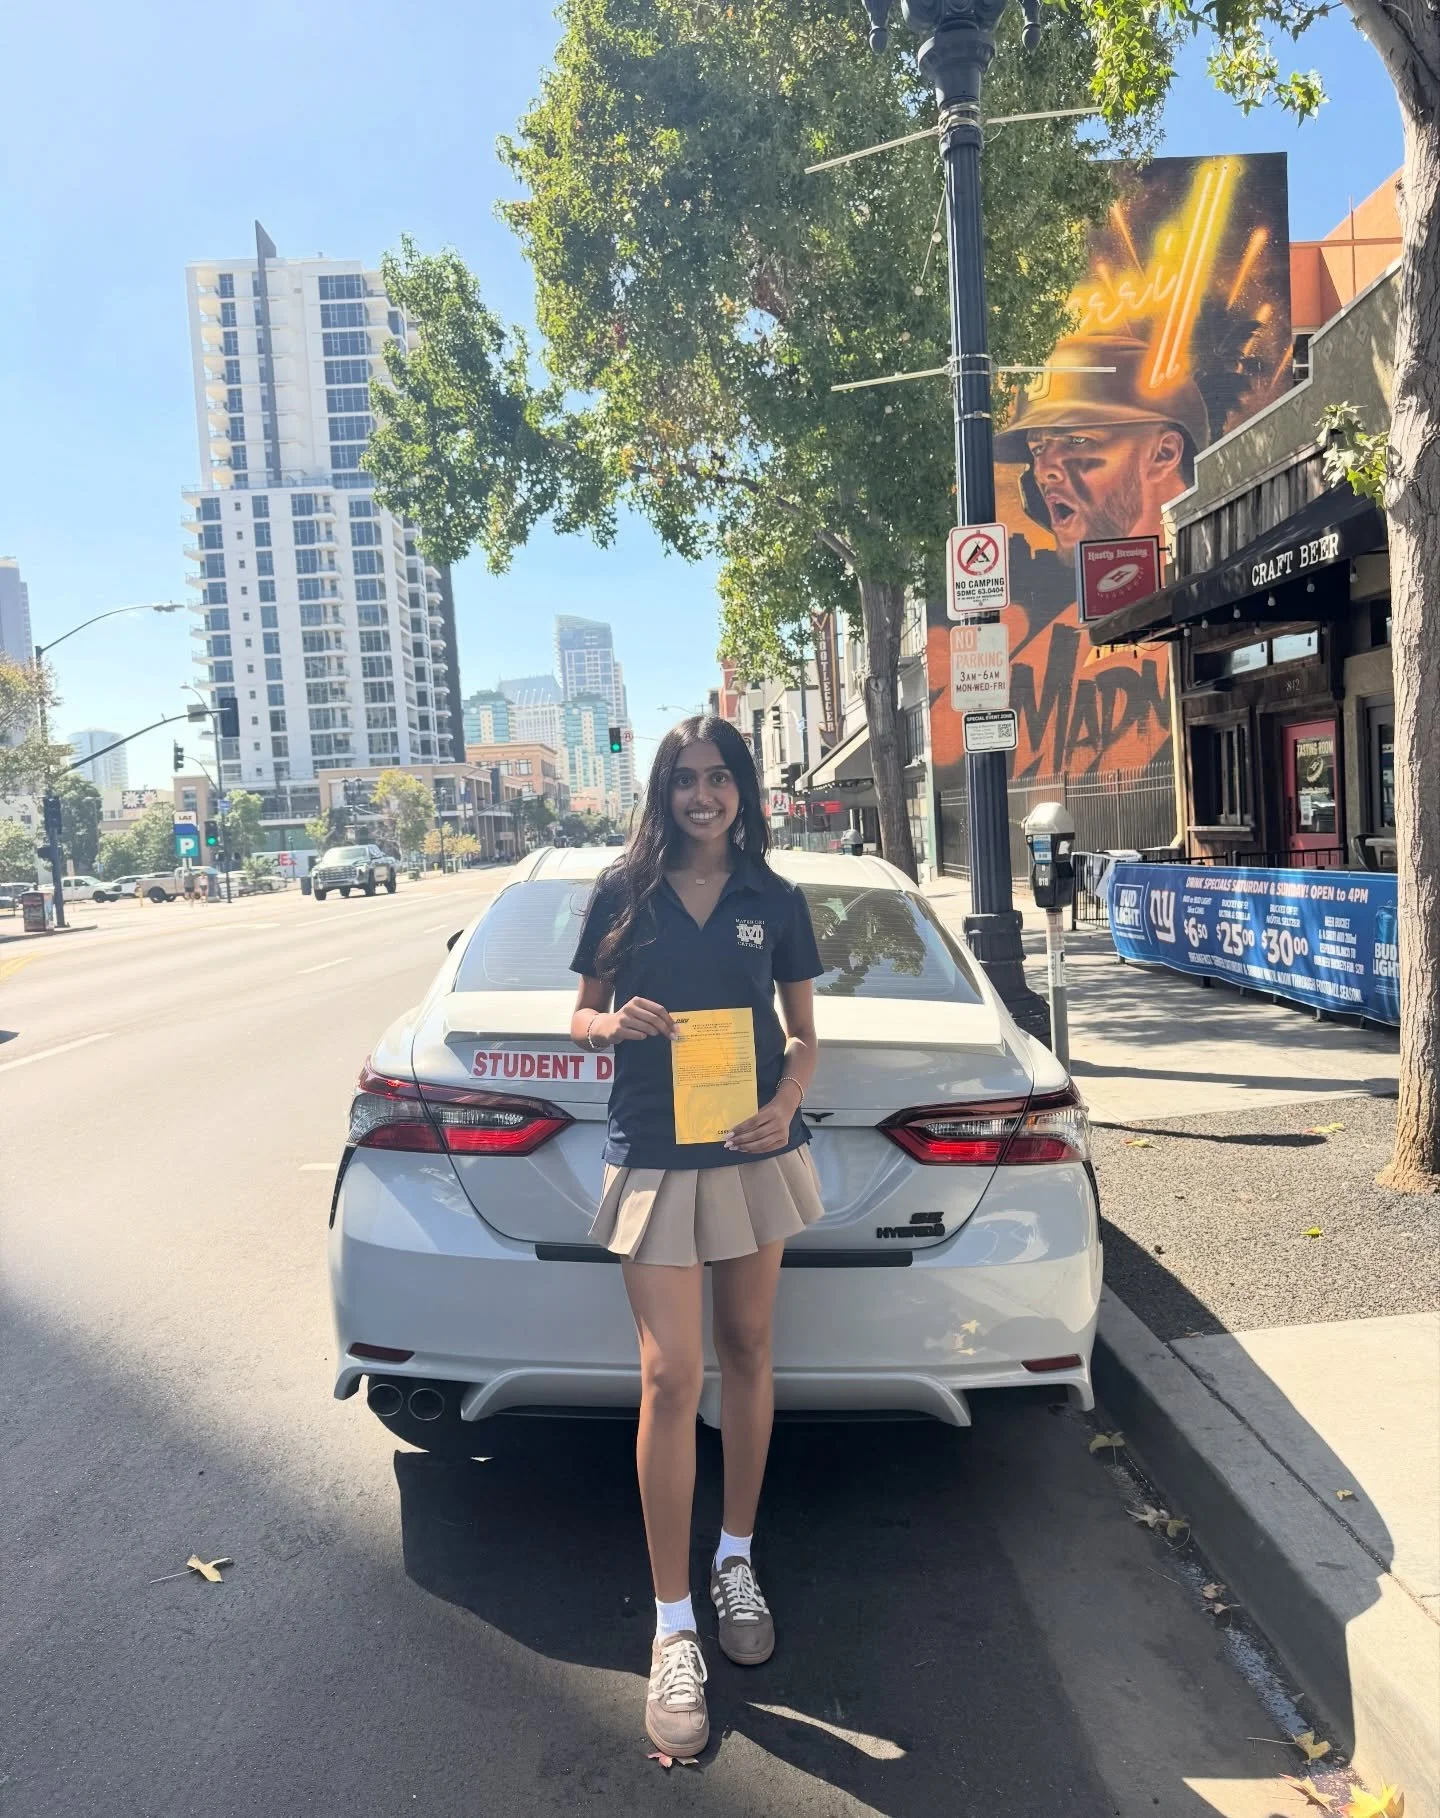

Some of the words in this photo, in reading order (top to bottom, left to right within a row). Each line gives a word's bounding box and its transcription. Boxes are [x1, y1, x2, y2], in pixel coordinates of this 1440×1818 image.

[1251, 550, 1293, 587] CRAFT
[1299, 532, 1339, 568] BEER
[955, 581, 966, 590] NO
[968, 577, 1005, 589] CAMPING
[956, 589, 976, 597] SDMC
[977, 587, 1004, 595] 63.0404
[954, 630, 974, 649] NO
[955, 651, 1003, 669] PARKING
[956, 681, 1006, 693] MON-WED-FRI
[1296, 742, 1318, 758] TASTING
[1318, 740, 1334, 755] ROOM
[1120, 889, 1137, 907] BUD
[1203, 878, 1232, 891] SPECIALS
[1231, 880, 1269, 895] SATURDAY
[1269, 882, 1276, 895] &
[1276, 882, 1309, 898] SUNDAY!
[1310, 885, 1335, 901] OPEN
[1336, 888, 1346, 902] to
[1347, 887, 1369, 904] 4PM
[1115, 906, 1140, 926] LIGHT
[1374, 942, 1398, 960] BUD
[473, 1051, 585, 1080] STUDENT
[596, 1055, 613, 1080] D
